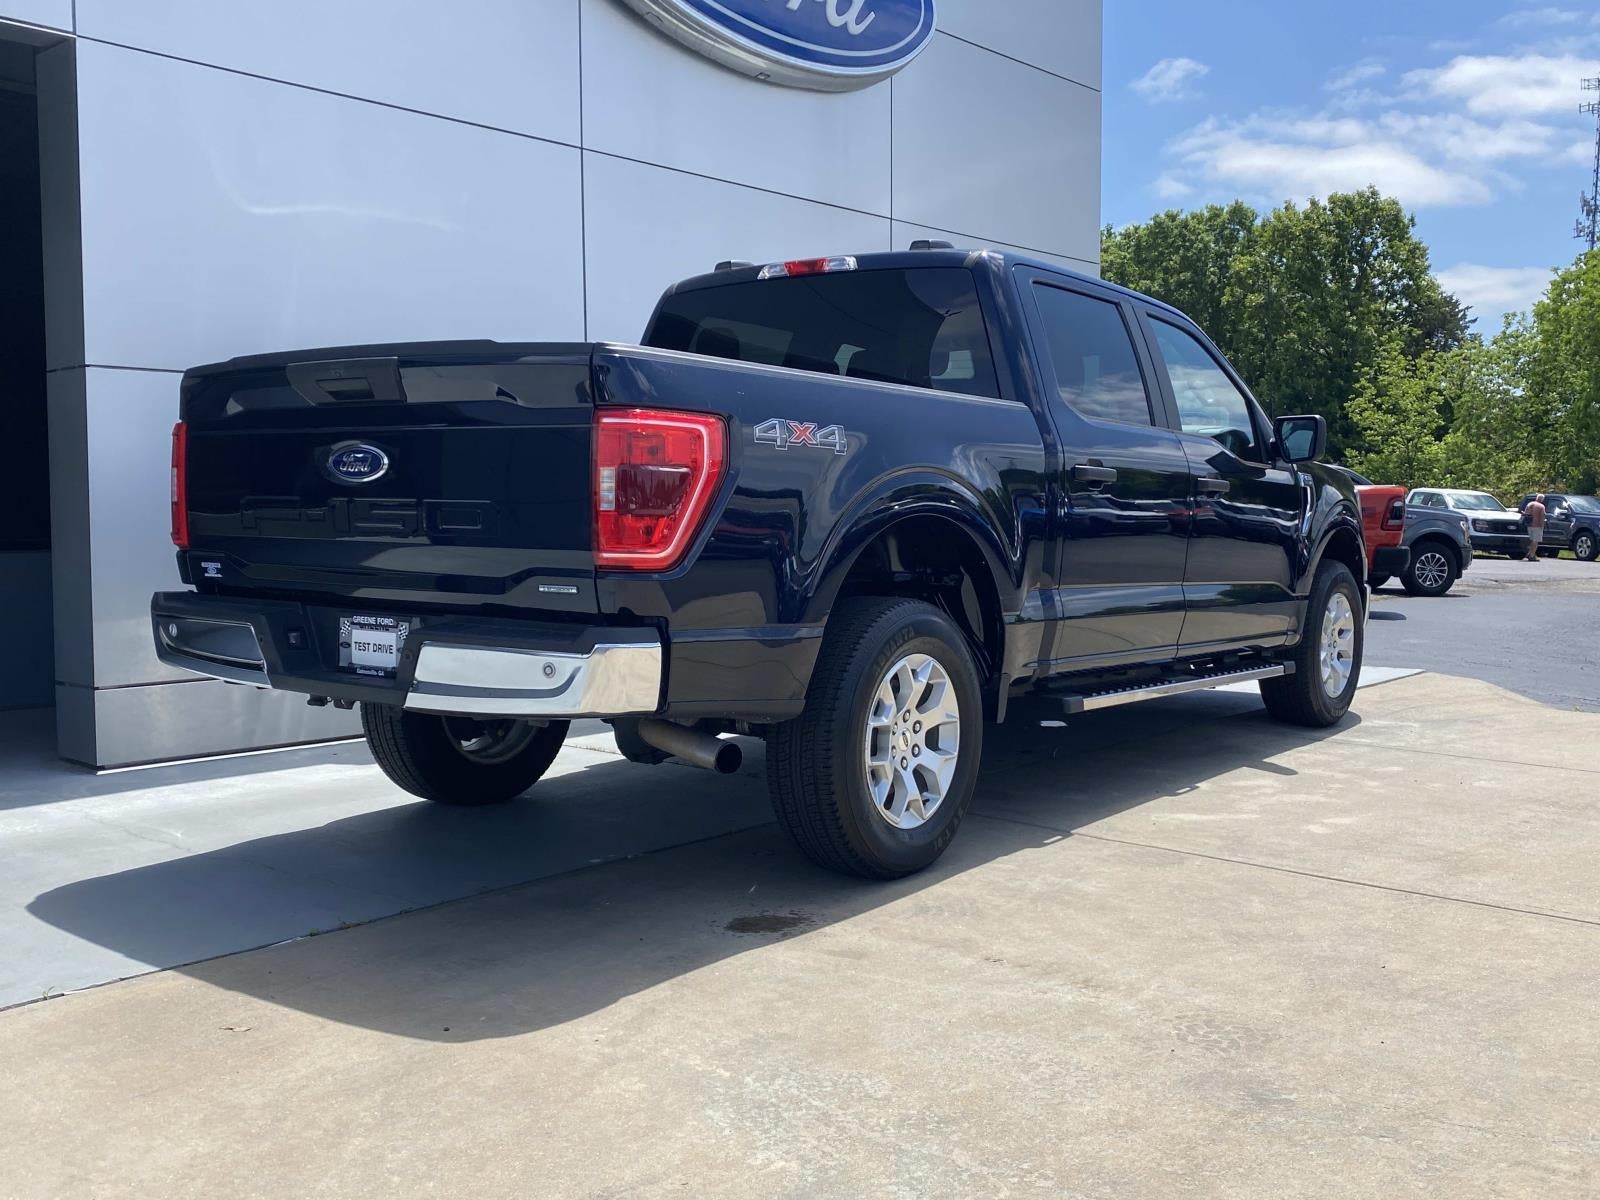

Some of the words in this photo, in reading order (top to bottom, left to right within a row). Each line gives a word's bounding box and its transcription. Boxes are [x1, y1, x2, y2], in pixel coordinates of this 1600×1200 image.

[353, 616, 376, 624] GREENE
[377, 617, 394, 625] FORD
[354, 641, 371, 652] TEST
[373, 643, 394, 654] DRIVE
